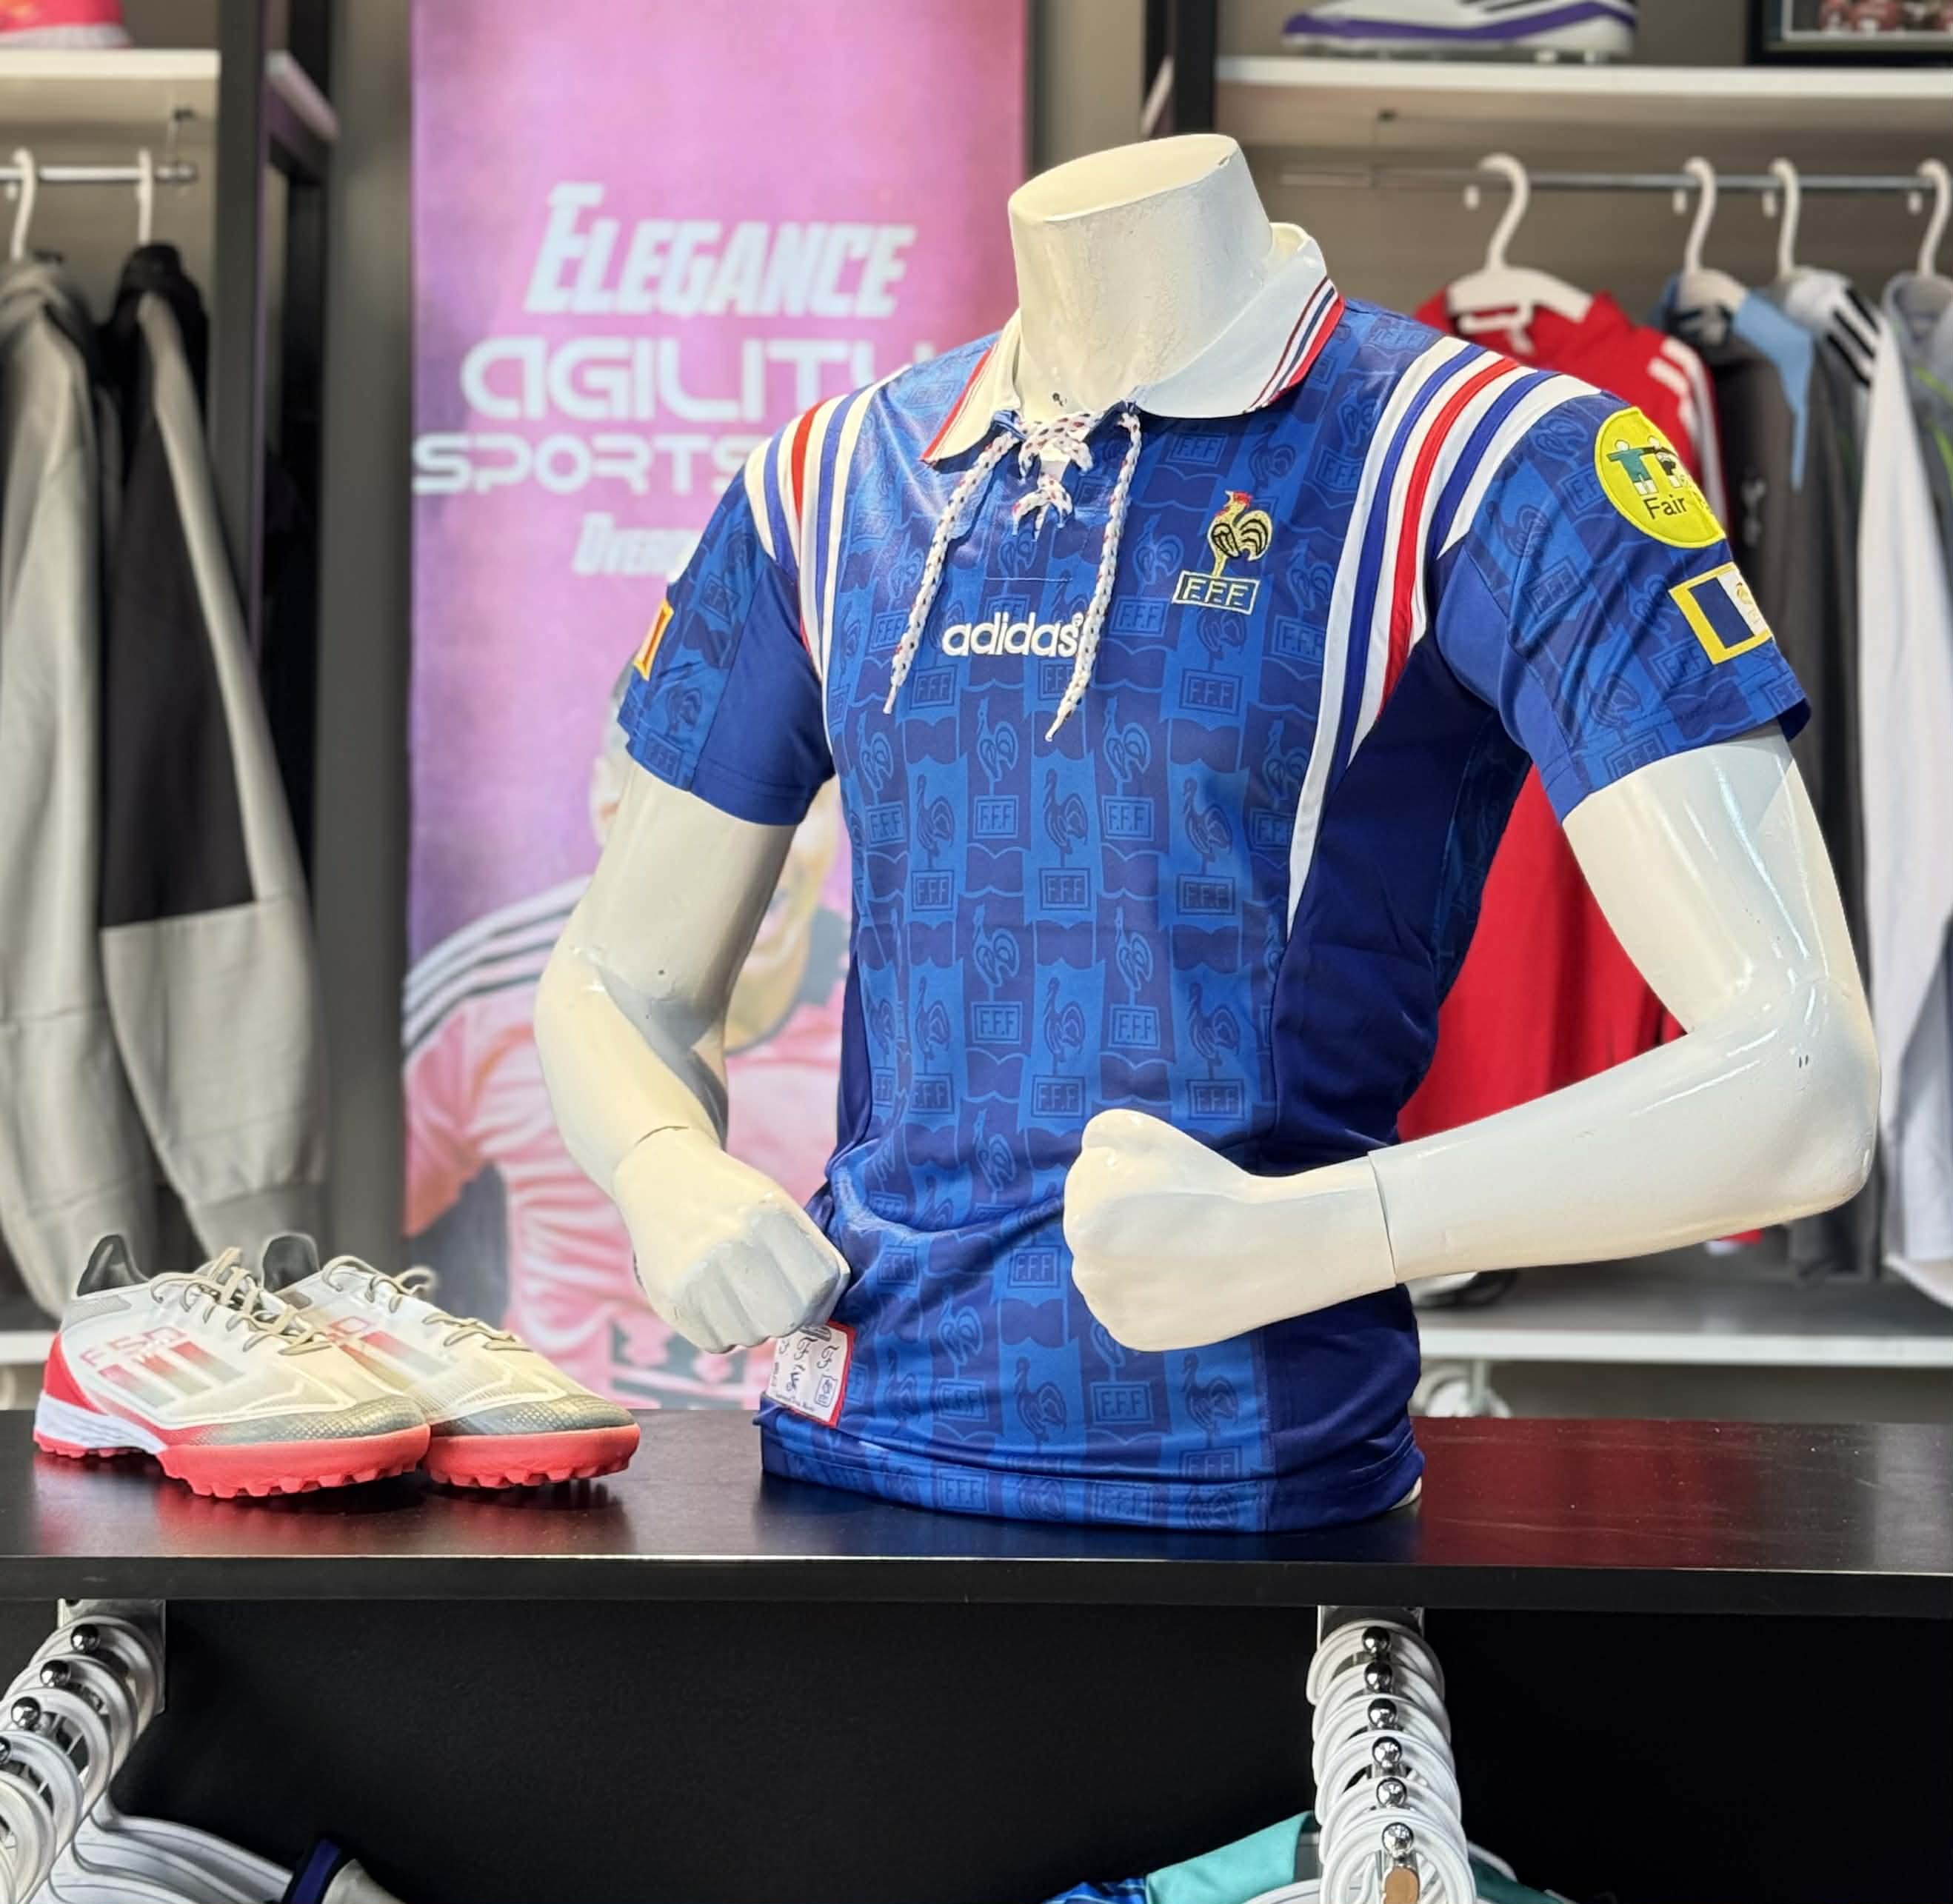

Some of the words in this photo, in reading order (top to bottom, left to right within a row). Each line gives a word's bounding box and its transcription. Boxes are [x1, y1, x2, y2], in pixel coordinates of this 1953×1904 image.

[524, 182, 916, 318] ELEGANCE
[1643, 494, 1687, 519] Fair
[942, 612, 1079, 658] adidas
